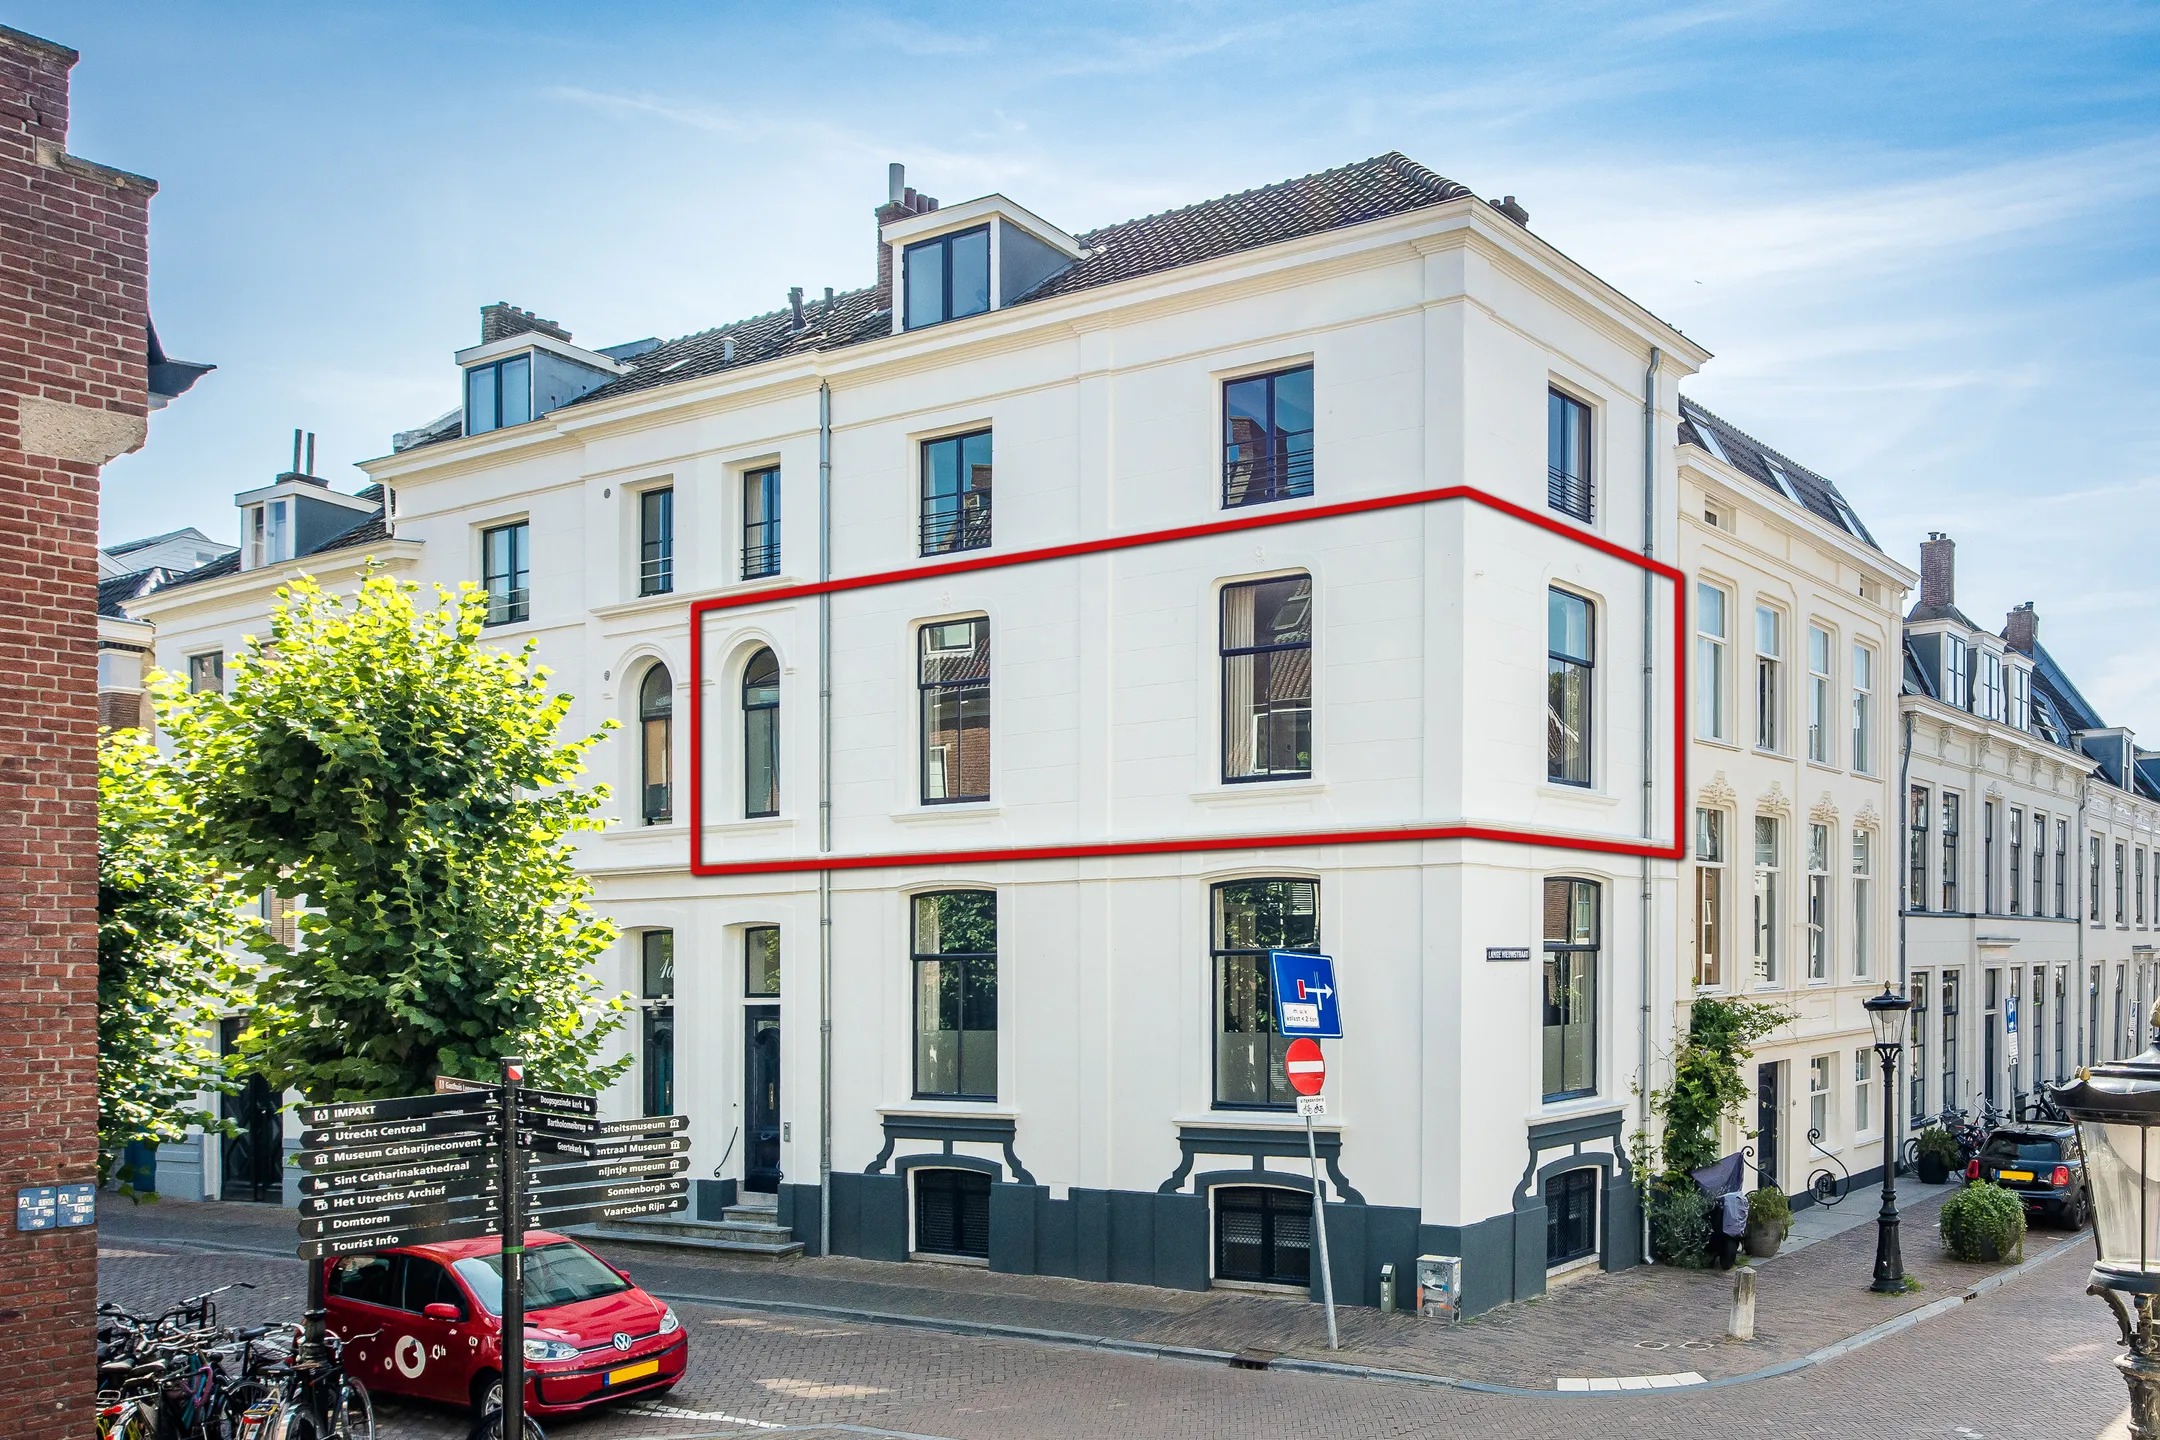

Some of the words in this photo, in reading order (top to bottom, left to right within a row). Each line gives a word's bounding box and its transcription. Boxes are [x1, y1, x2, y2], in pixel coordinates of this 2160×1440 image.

[540, 1095, 571, 1107] Doopsgezinde
[572, 1099, 582, 1109] kerk
[334, 1106, 376, 1118] IMPAKT
[335, 1128, 378, 1141] Utrecht
[380, 1123, 426, 1136] Centraal
[334, 1149, 383, 1162] Museum
[385, 1138, 482, 1156] Catharijneconvent
[557, 1142, 582, 1154] Geertekerk
[597, 1144, 627, 1156] entraal
[629, 1142, 666, 1153] Museum
[334, 1175, 358, 1186] Sint
[360, 1161, 470, 1182] Catharinakathedraal
[598, 1165, 628, 1177] nijntje
[629, 1163, 666, 1173] museum
[333, 1197, 355, 1208] Het
[357, 1192, 404, 1205] Utrechts
[407, 1185, 446, 1199] Archief
[607, 1183, 666, 1197] Sonnenborgh
[603, 1204, 647, 1217] Vaartsche
[648, 1202, 665, 1212] Rijn
[333, 1215, 390, 1229] Domtoren
[332, 1238, 373, 1252] Tourist
[376, 1235, 399, 1246] Info
